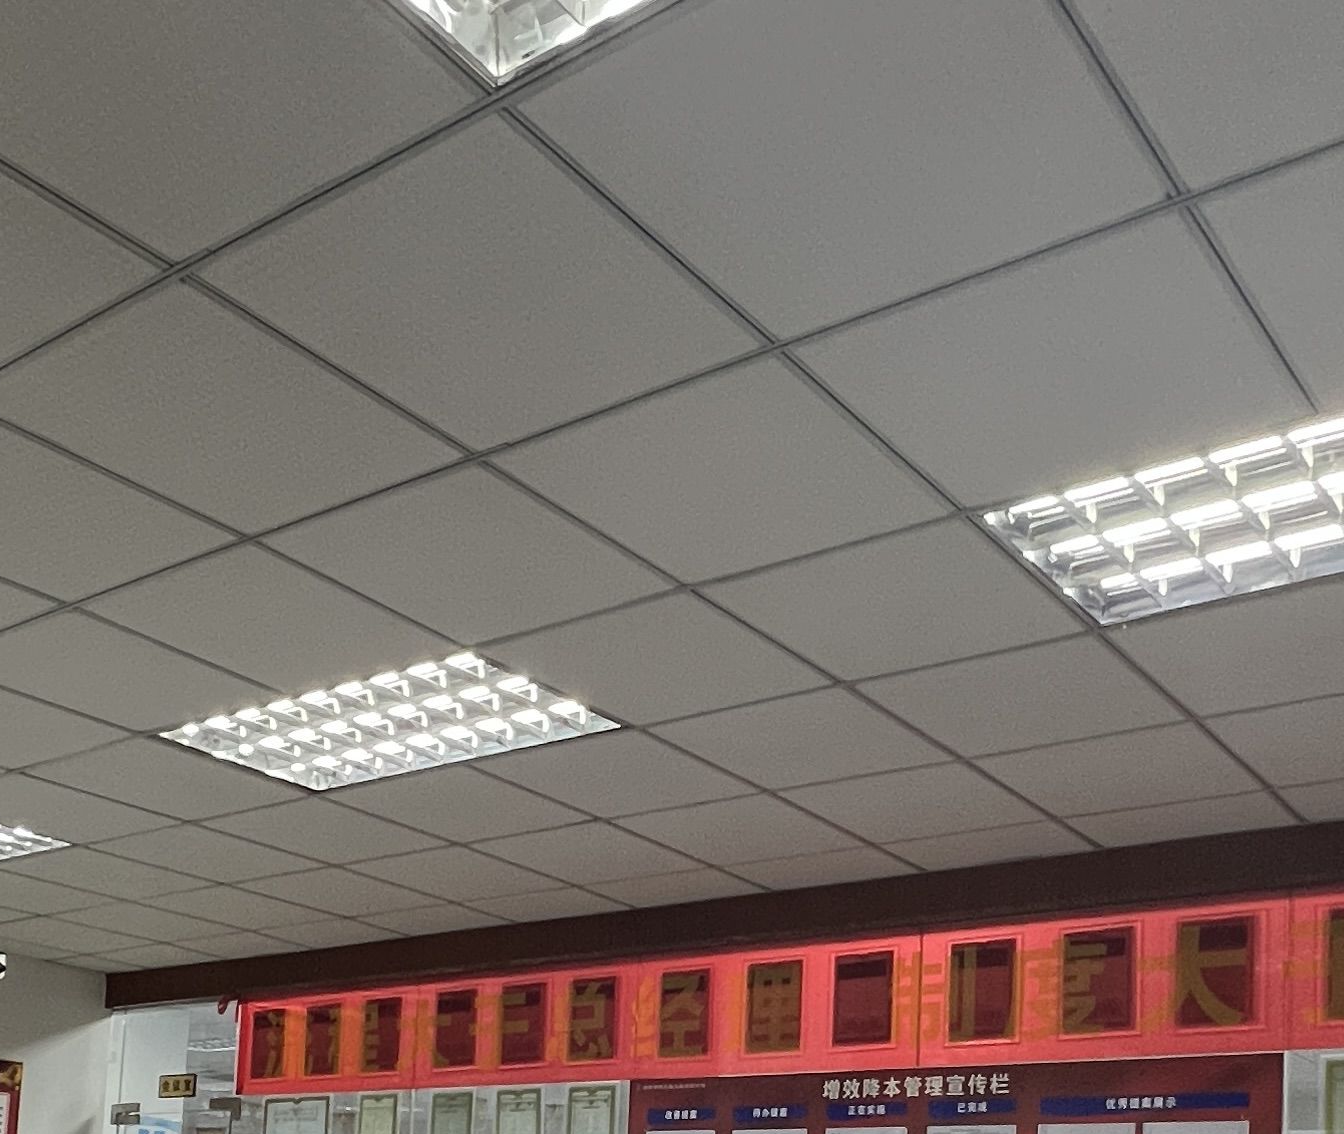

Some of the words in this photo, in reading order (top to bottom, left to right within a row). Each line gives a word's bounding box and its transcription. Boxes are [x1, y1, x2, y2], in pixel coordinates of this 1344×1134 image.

[821, 1073, 1010, 1100] 增效降本管理宣传栏
[957, 1102, 988, 1113] 已完成
